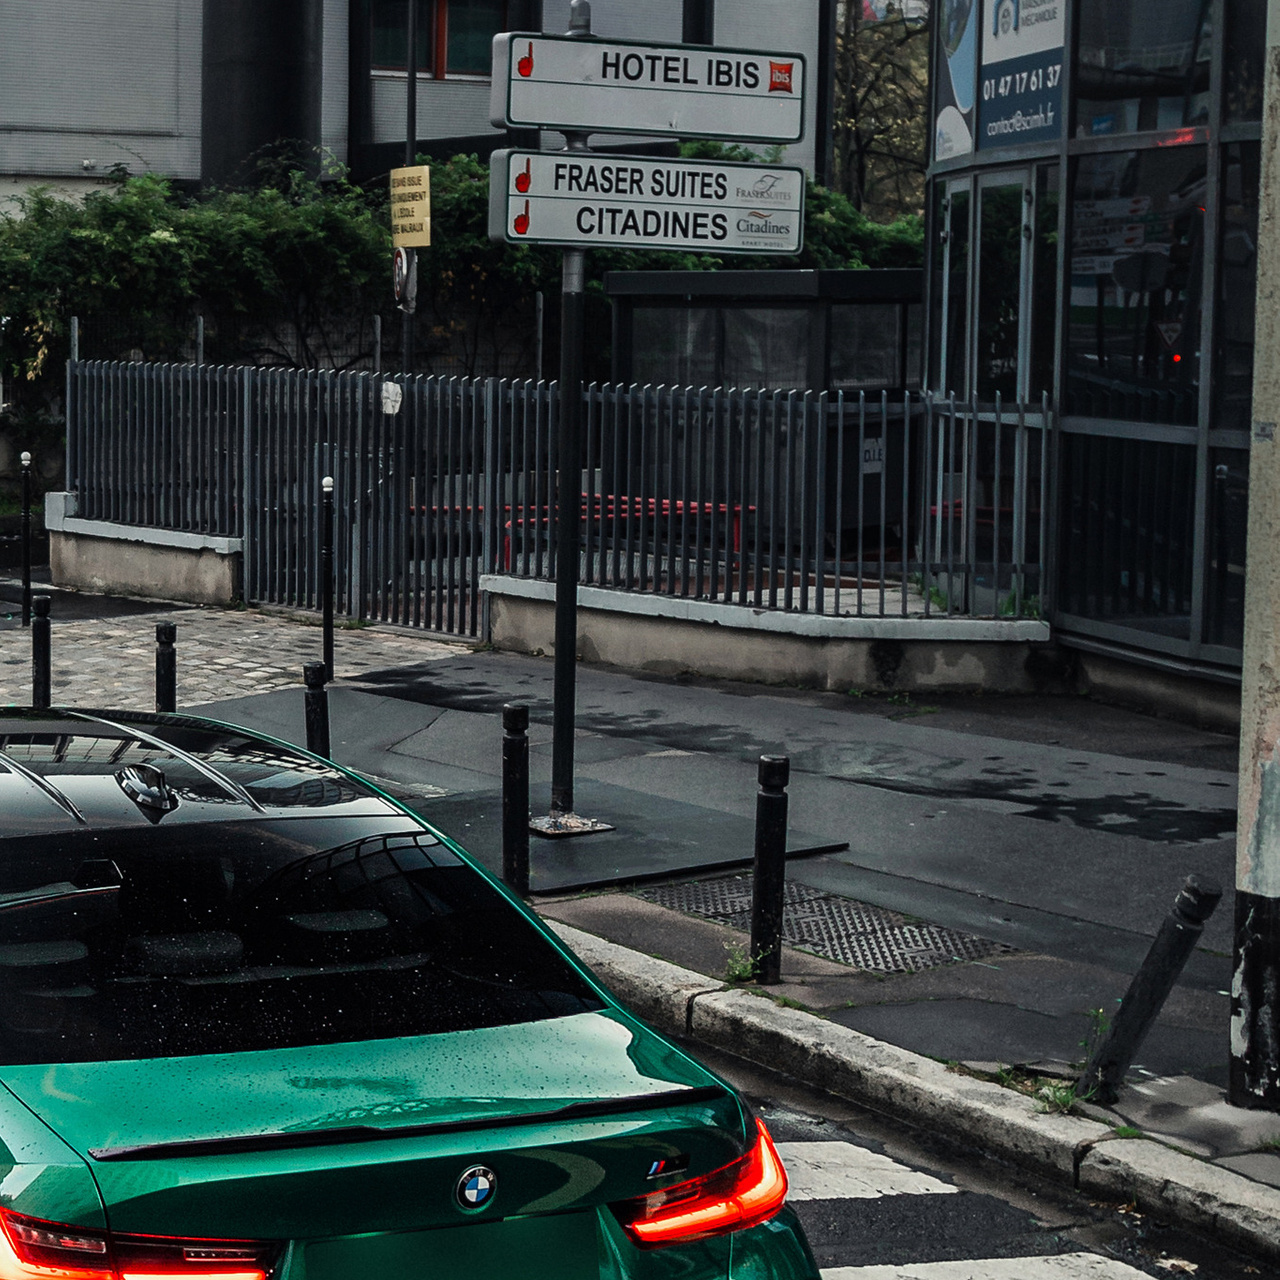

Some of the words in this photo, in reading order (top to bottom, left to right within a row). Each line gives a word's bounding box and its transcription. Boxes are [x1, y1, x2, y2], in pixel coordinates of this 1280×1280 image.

[601, 51, 698, 85] HOTEL
[707, 59, 760, 89] IBIS
[772, 69, 790, 84] ibis
[983, 79, 996, 101] 01
[998, 75, 1012, 98] 47
[1015, 71, 1028, 95] 17
[1030, 68, 1043, 92] 61
[1047, 64, 1062, 89] 37
[554, 163, 644, 196] FRASER
[651, 169, 728, 201] SUITES
[576, 206, 728, 240] CITADINES
[736, 218, 790, 235] Citadines
